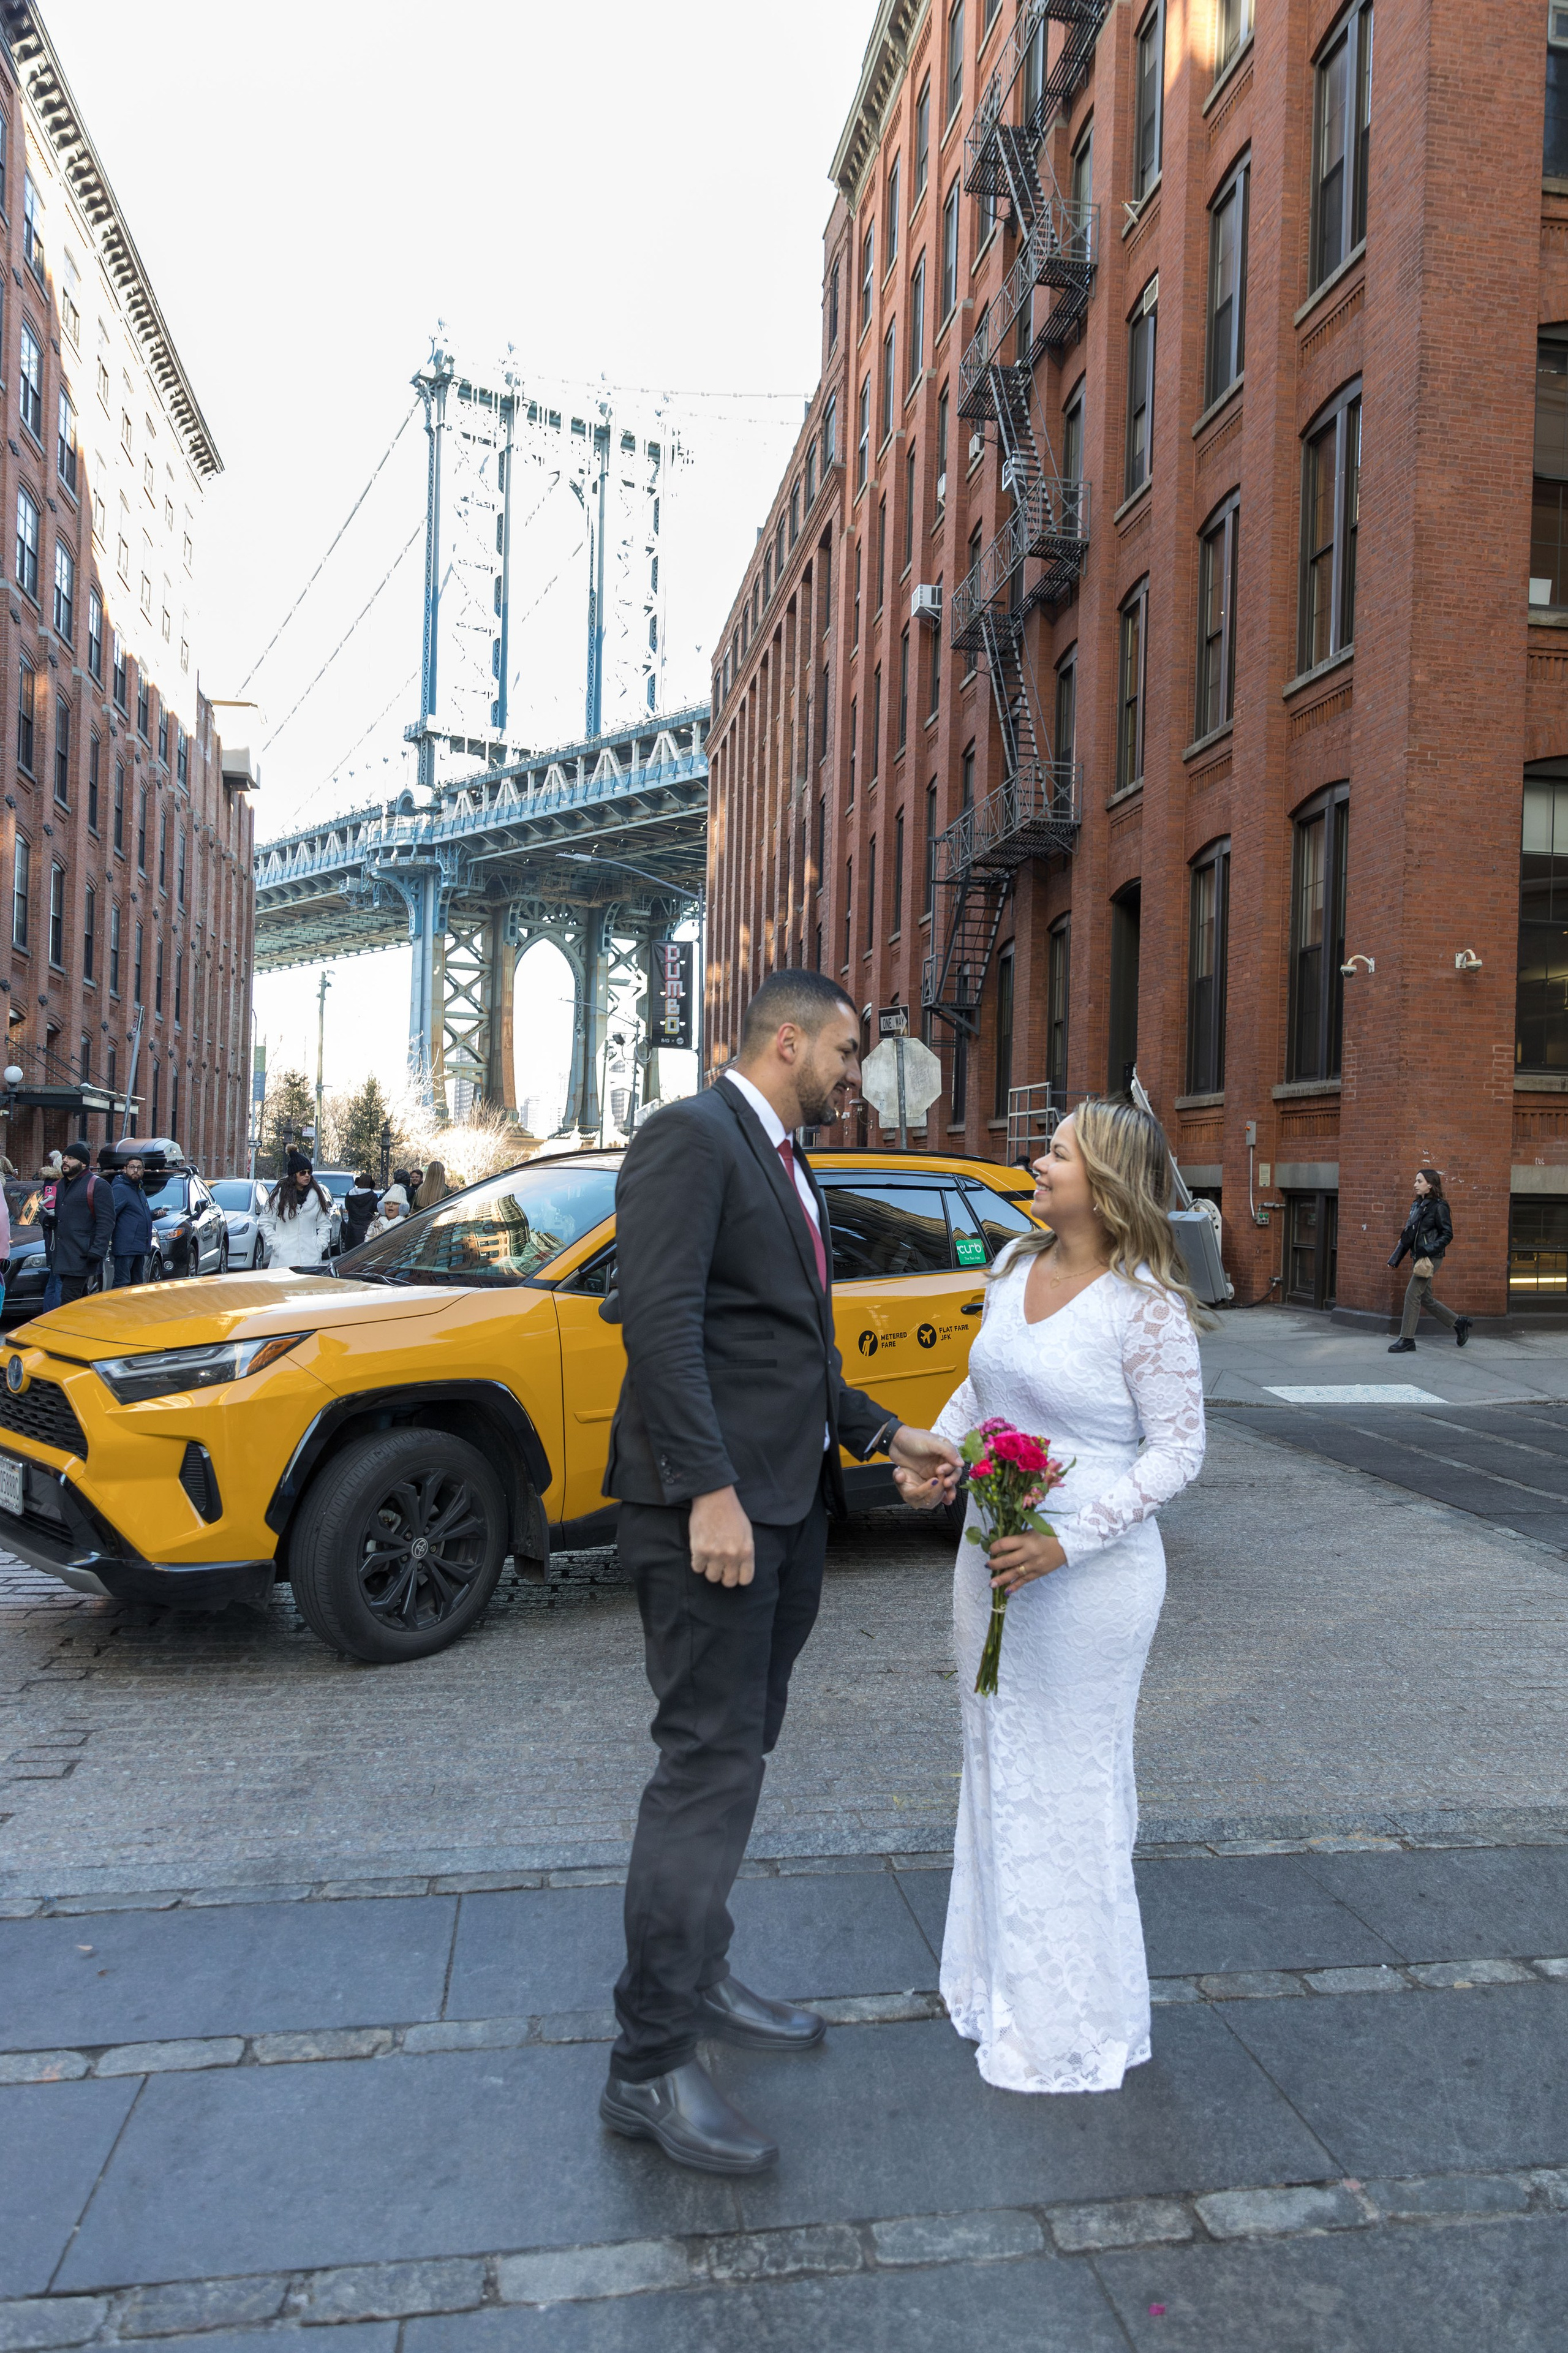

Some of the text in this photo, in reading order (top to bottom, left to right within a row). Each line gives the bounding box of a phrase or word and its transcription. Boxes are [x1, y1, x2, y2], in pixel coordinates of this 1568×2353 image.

[665, 945, 683, 1034] DUMBO
[883, 1016, 905, 1029] ONE WAY
[957, 1243, 982, 1254] curb
[881, 1332, 907, 1340] METERED
